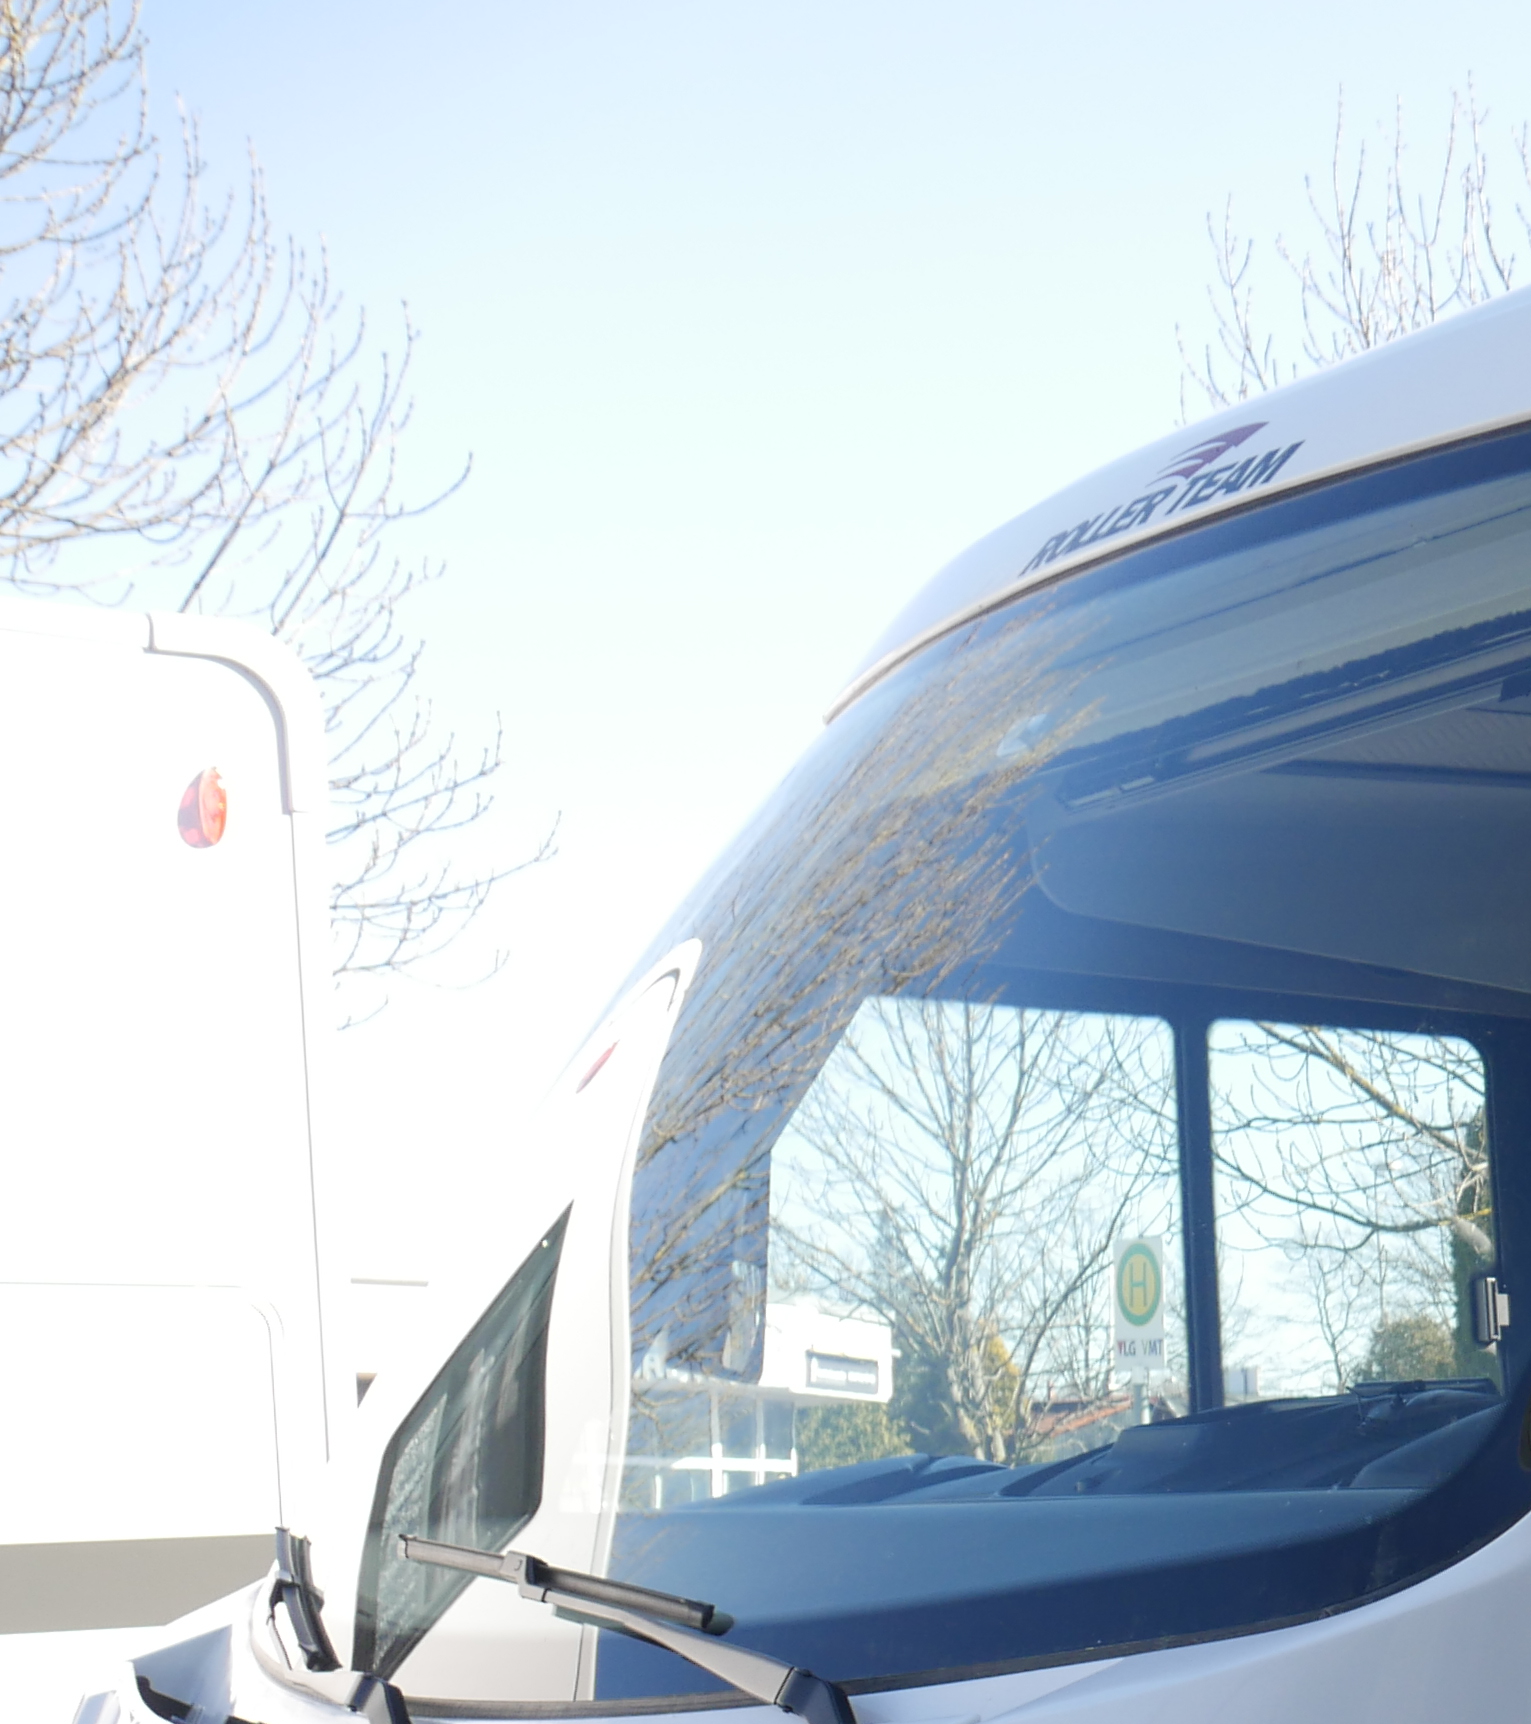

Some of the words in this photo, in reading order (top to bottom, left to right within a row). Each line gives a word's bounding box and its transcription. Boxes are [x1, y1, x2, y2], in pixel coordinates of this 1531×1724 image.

[1017, 484, 1178, 577] ROLLER
[1165, 439, 1307, 515] TEAM
[1129, 1261, 1147, 1308] H
